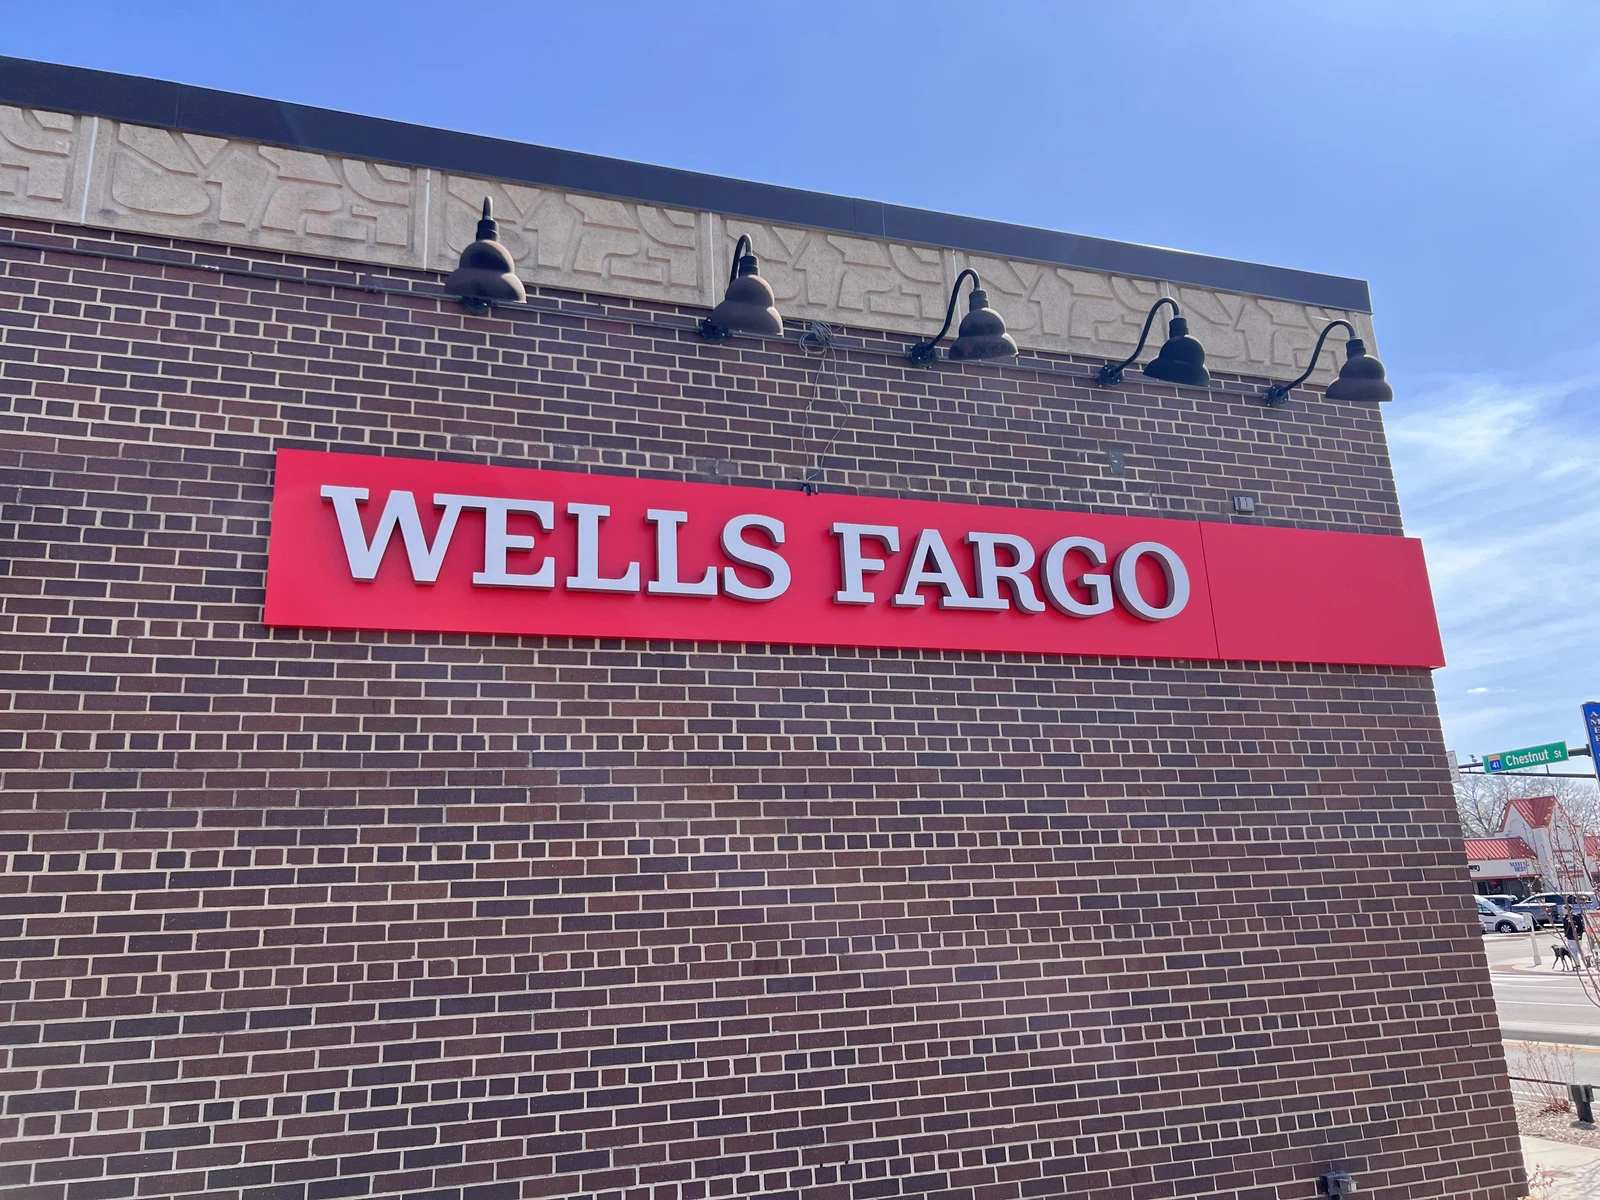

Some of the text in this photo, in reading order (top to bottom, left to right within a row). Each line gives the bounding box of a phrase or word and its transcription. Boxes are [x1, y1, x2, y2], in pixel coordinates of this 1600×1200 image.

[319, 484, 1191, 622] WELLS FARGO
[1492, 749, 1562, 769] 41 Chestnut St
